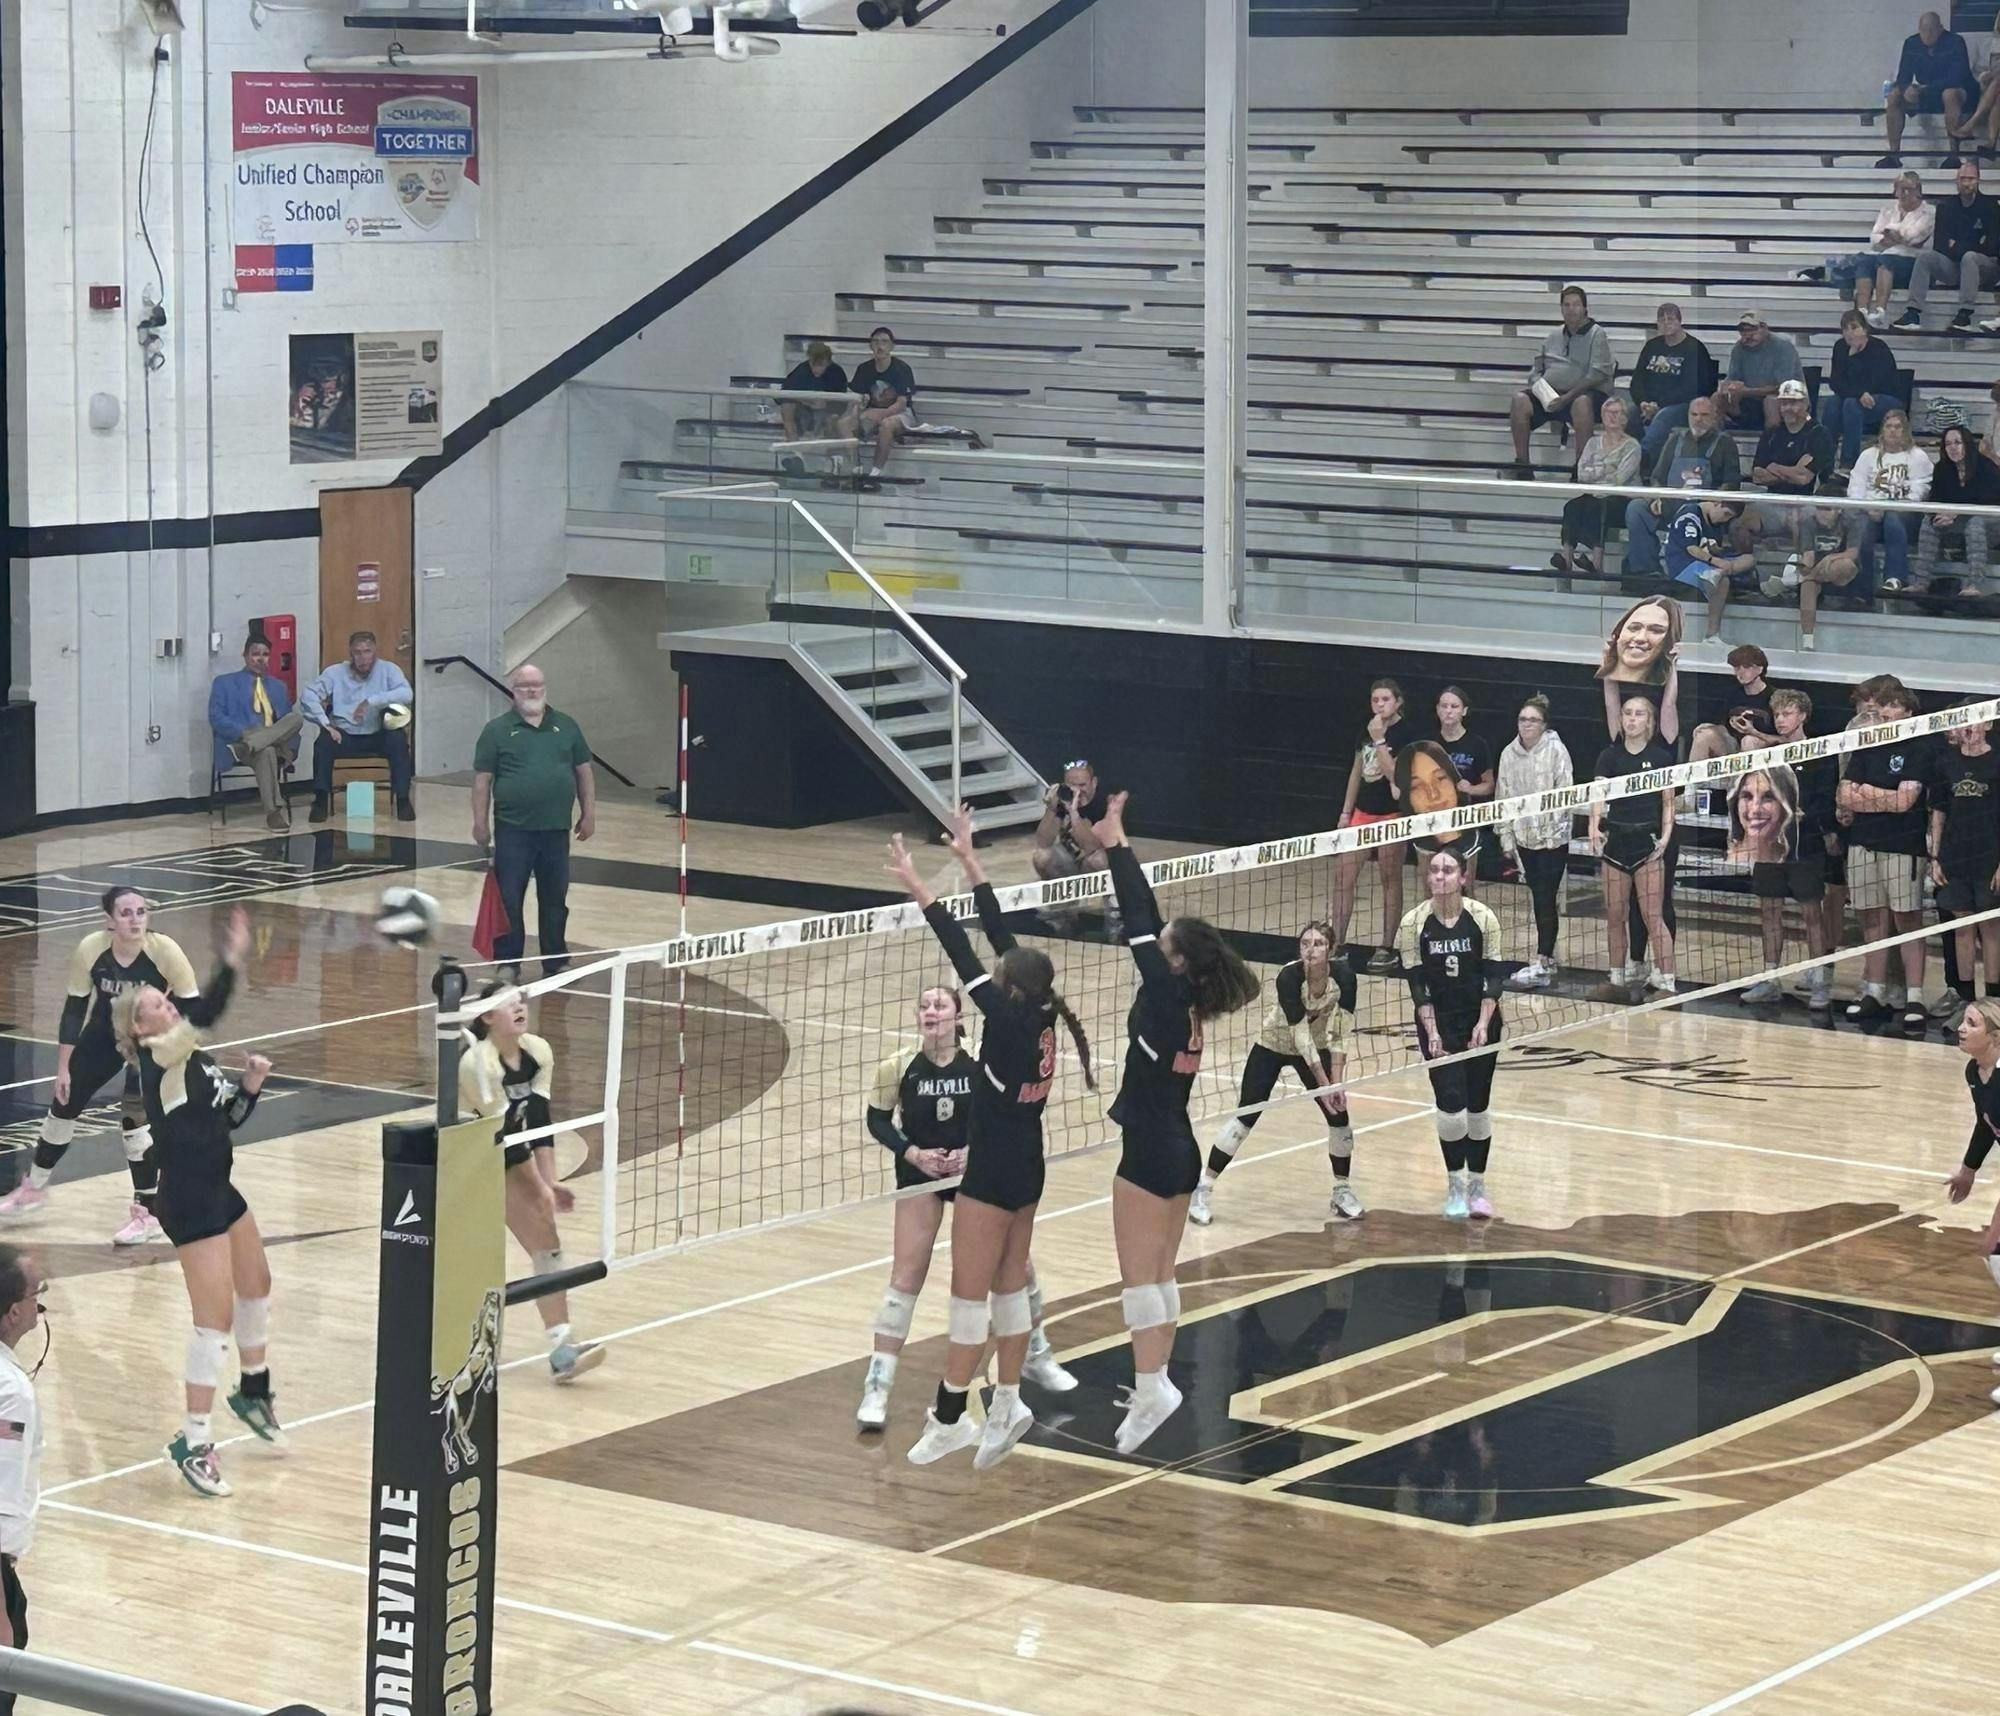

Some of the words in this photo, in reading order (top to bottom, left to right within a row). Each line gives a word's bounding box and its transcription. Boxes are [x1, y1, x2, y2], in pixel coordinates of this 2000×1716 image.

[265, 98, 345, 115] DALEVILLE
[382, 133, 467, 150] TOGETHER
[238, 163, 296, 186] Unified
[303, 163, 384, 190] Champion
[285, 199, 341, 222] School
[800, 911, 875, 942] DALEVILLE
[1042, 873, 1107, 904] DALEVILLE
[443, 1476, 481, 1716] BRONCOS
